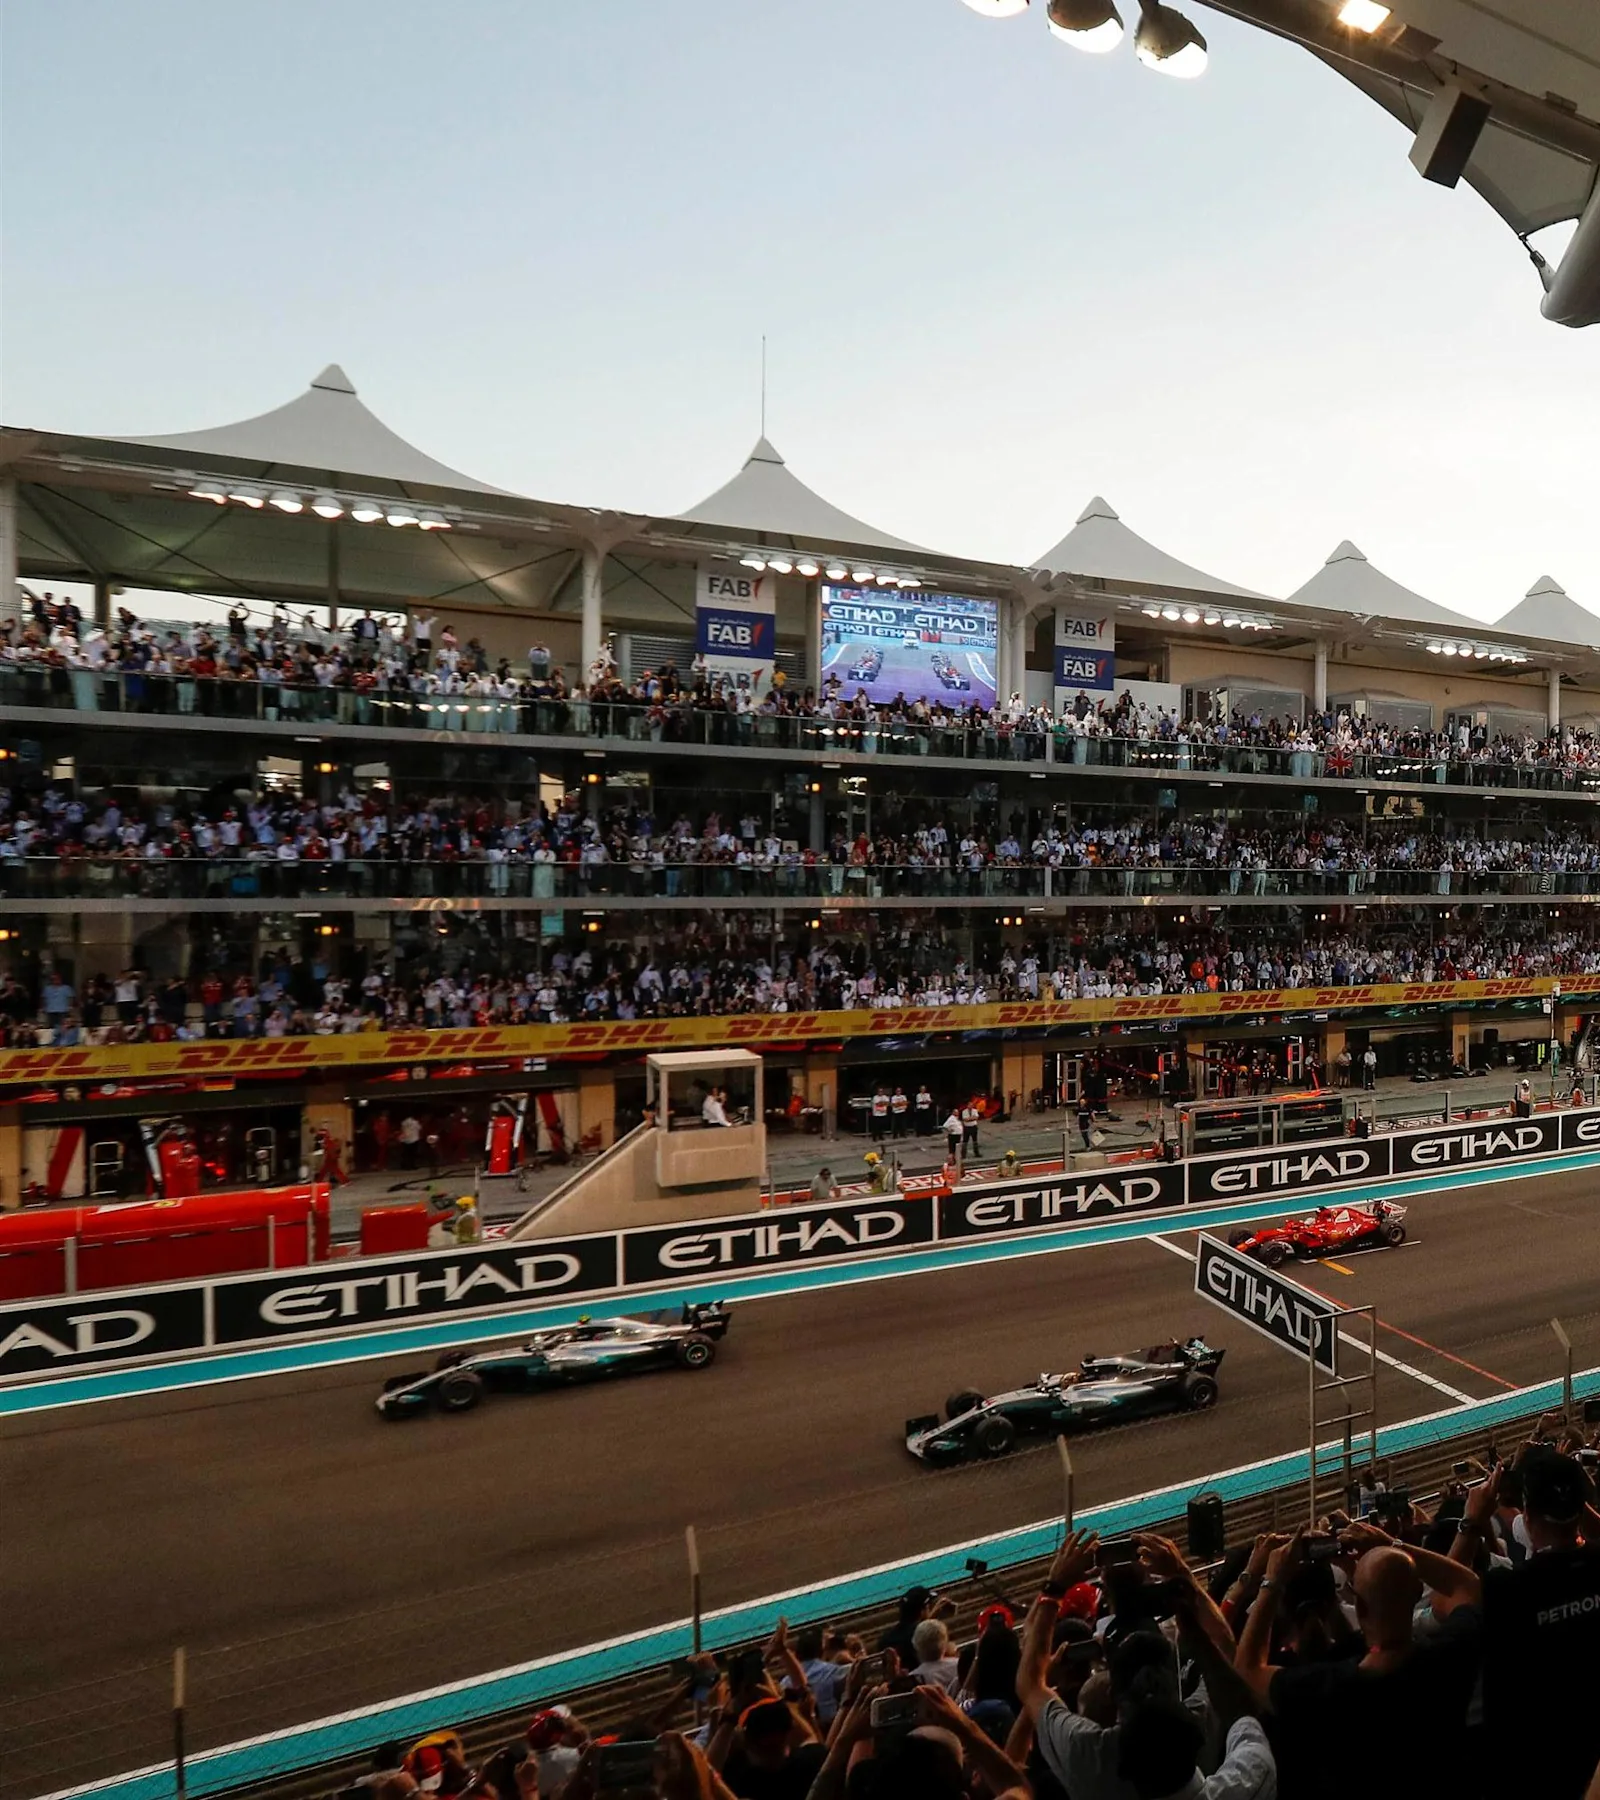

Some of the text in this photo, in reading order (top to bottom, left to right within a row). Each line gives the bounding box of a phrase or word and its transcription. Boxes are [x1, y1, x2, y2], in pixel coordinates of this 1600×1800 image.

[708, 577, 750, 597] FAB
[828, 604, 897, 624] ETIHAD
[914, 614, 978, 632] ETIHAD
[708, 623, 751, 645] FAB
[824, 623, 865, 634] ETIHAD
[875, 627, 912, 638] ETIHA
[1064, 619, 1096, 637] FAB
[1063, 660, 1096, 678] FAB
[1315, 988, 1375, 1005] DHL
[1403, 985, 1458, 1001] DHL
[1484, 978, 1535, 996] DHL
[1113, 998, 1187, 1017] DHL
[1218, 993, 1286, 1012] DHL
[869, 1010, 957, 1031] DHL
[998, 1003, 1077, 1023] DHL
[565, 1023, 675, 1046] DHL
[726, 1015, 824, 1038] DHL
[385, 1031, 506, 1057] DHL
[0, 1052, 101, 1078] HL
[177, 1041, 316, 1069] DHL
[1411, 1126, 1544, 1165] ETIHAD
[1210, 1149, 1371, 1193] ETIHAD
[965, 1177, 1161, 1226] ETIHAD
[658, 1211, 905, 1269] ETIHAD
[258, 1253, 582, 1325] ETIHAD
[1206, 1255, 1322, 1349] ETIHAD
